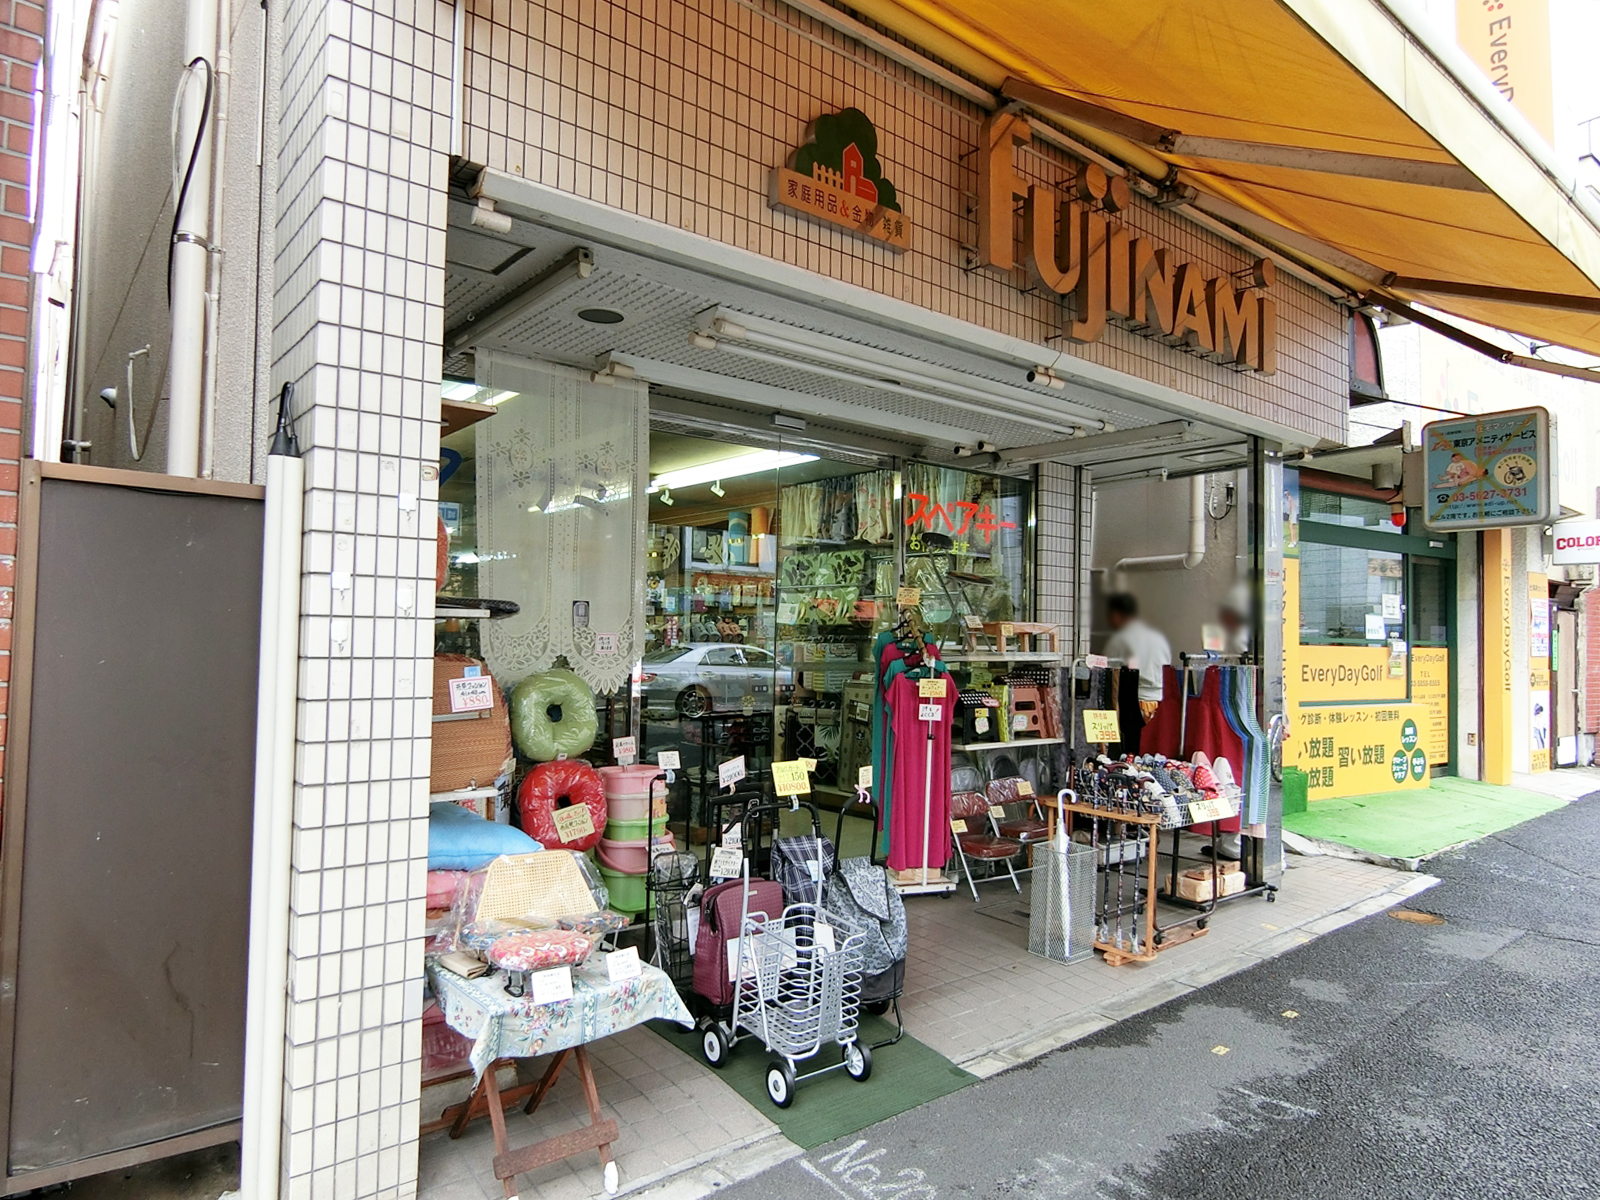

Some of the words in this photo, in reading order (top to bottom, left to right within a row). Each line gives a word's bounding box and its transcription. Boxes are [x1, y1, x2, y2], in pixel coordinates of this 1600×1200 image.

[1453, 430, 1537, 448] 東京アメニティサービス
[905, 492, 1017, 544] スペアキー
[1503, 576, 1512, 691] EveryDayGolf
[1411, 654, 1445, 664] EveryDayGolf
[1301, 664, 1383, 686] EveryDayGolf
[1339, 744, 1385, 768] 習い放題
[1299, 766, 1334, 788] 放題
